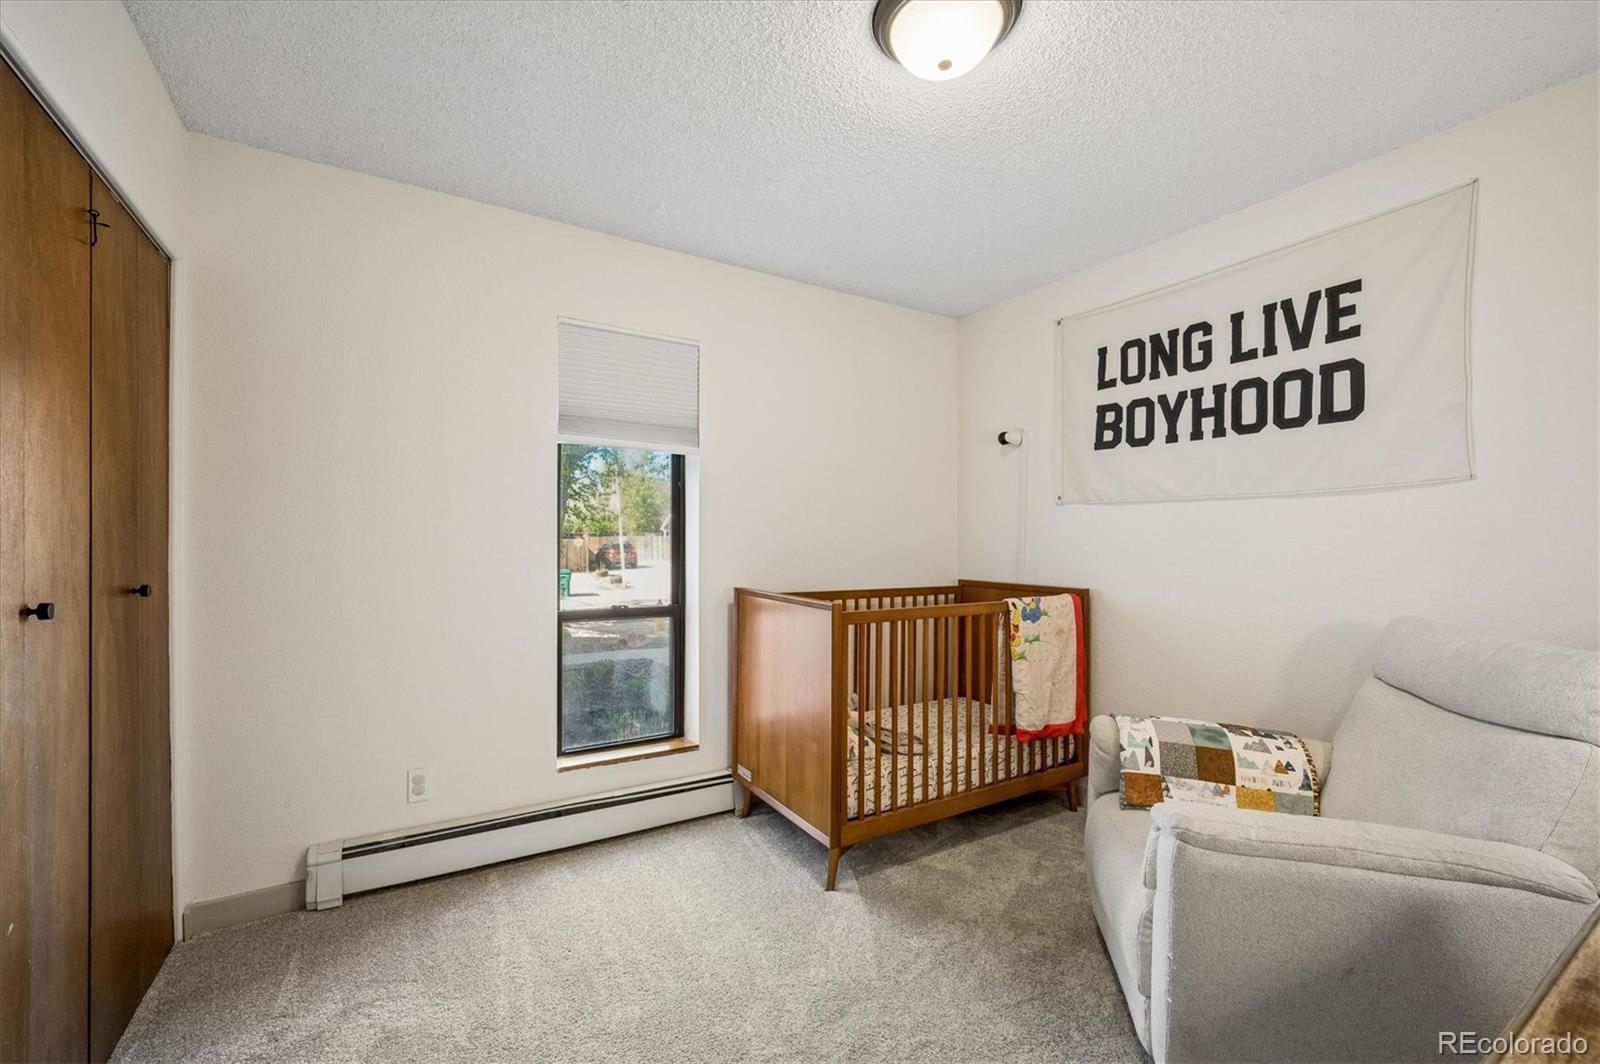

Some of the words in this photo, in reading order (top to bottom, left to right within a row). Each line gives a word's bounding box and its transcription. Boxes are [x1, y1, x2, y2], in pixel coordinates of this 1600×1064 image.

[1097, 320, 1213, 391] LONG
[1230, 279, 1363, 364] LIVE
[1094, 358, 1366, 451] BOYHOOD
